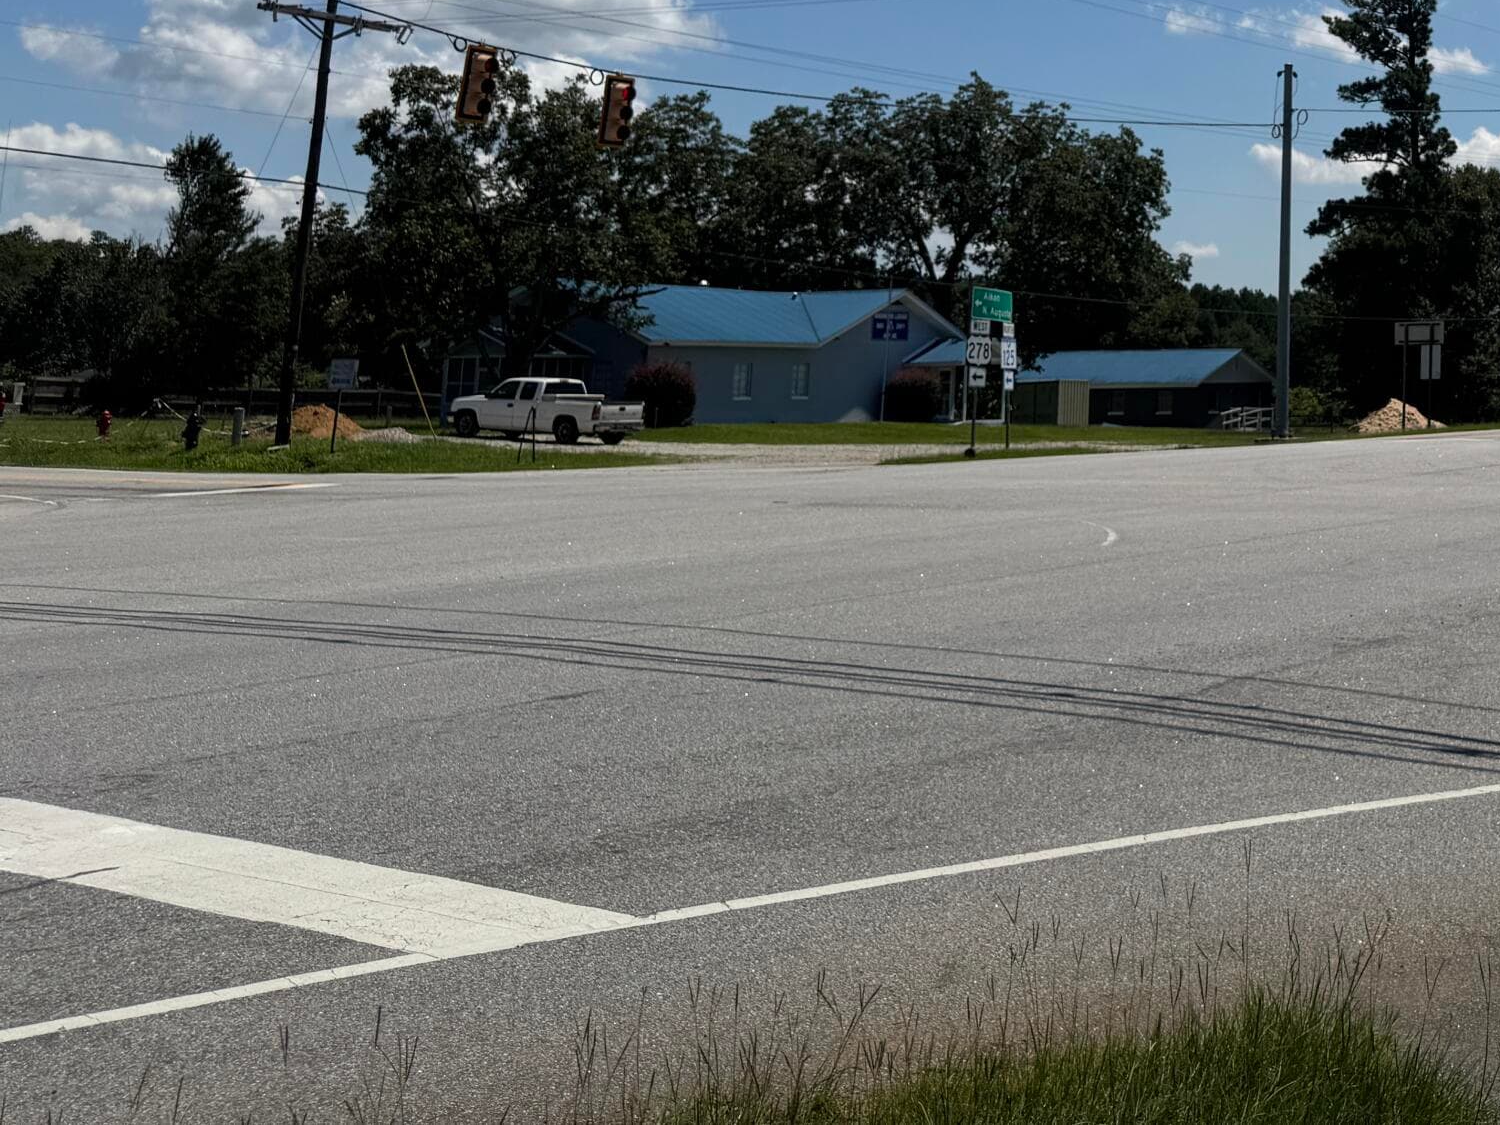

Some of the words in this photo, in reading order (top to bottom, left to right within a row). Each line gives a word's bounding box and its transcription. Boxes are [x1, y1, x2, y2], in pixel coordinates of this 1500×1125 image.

[990, 307, 1012, 320] Augusta
[973, 321, 988, 331] WEST
[968, 342, 990, 359] 278
[1003, 349, 1014, 366] 125
